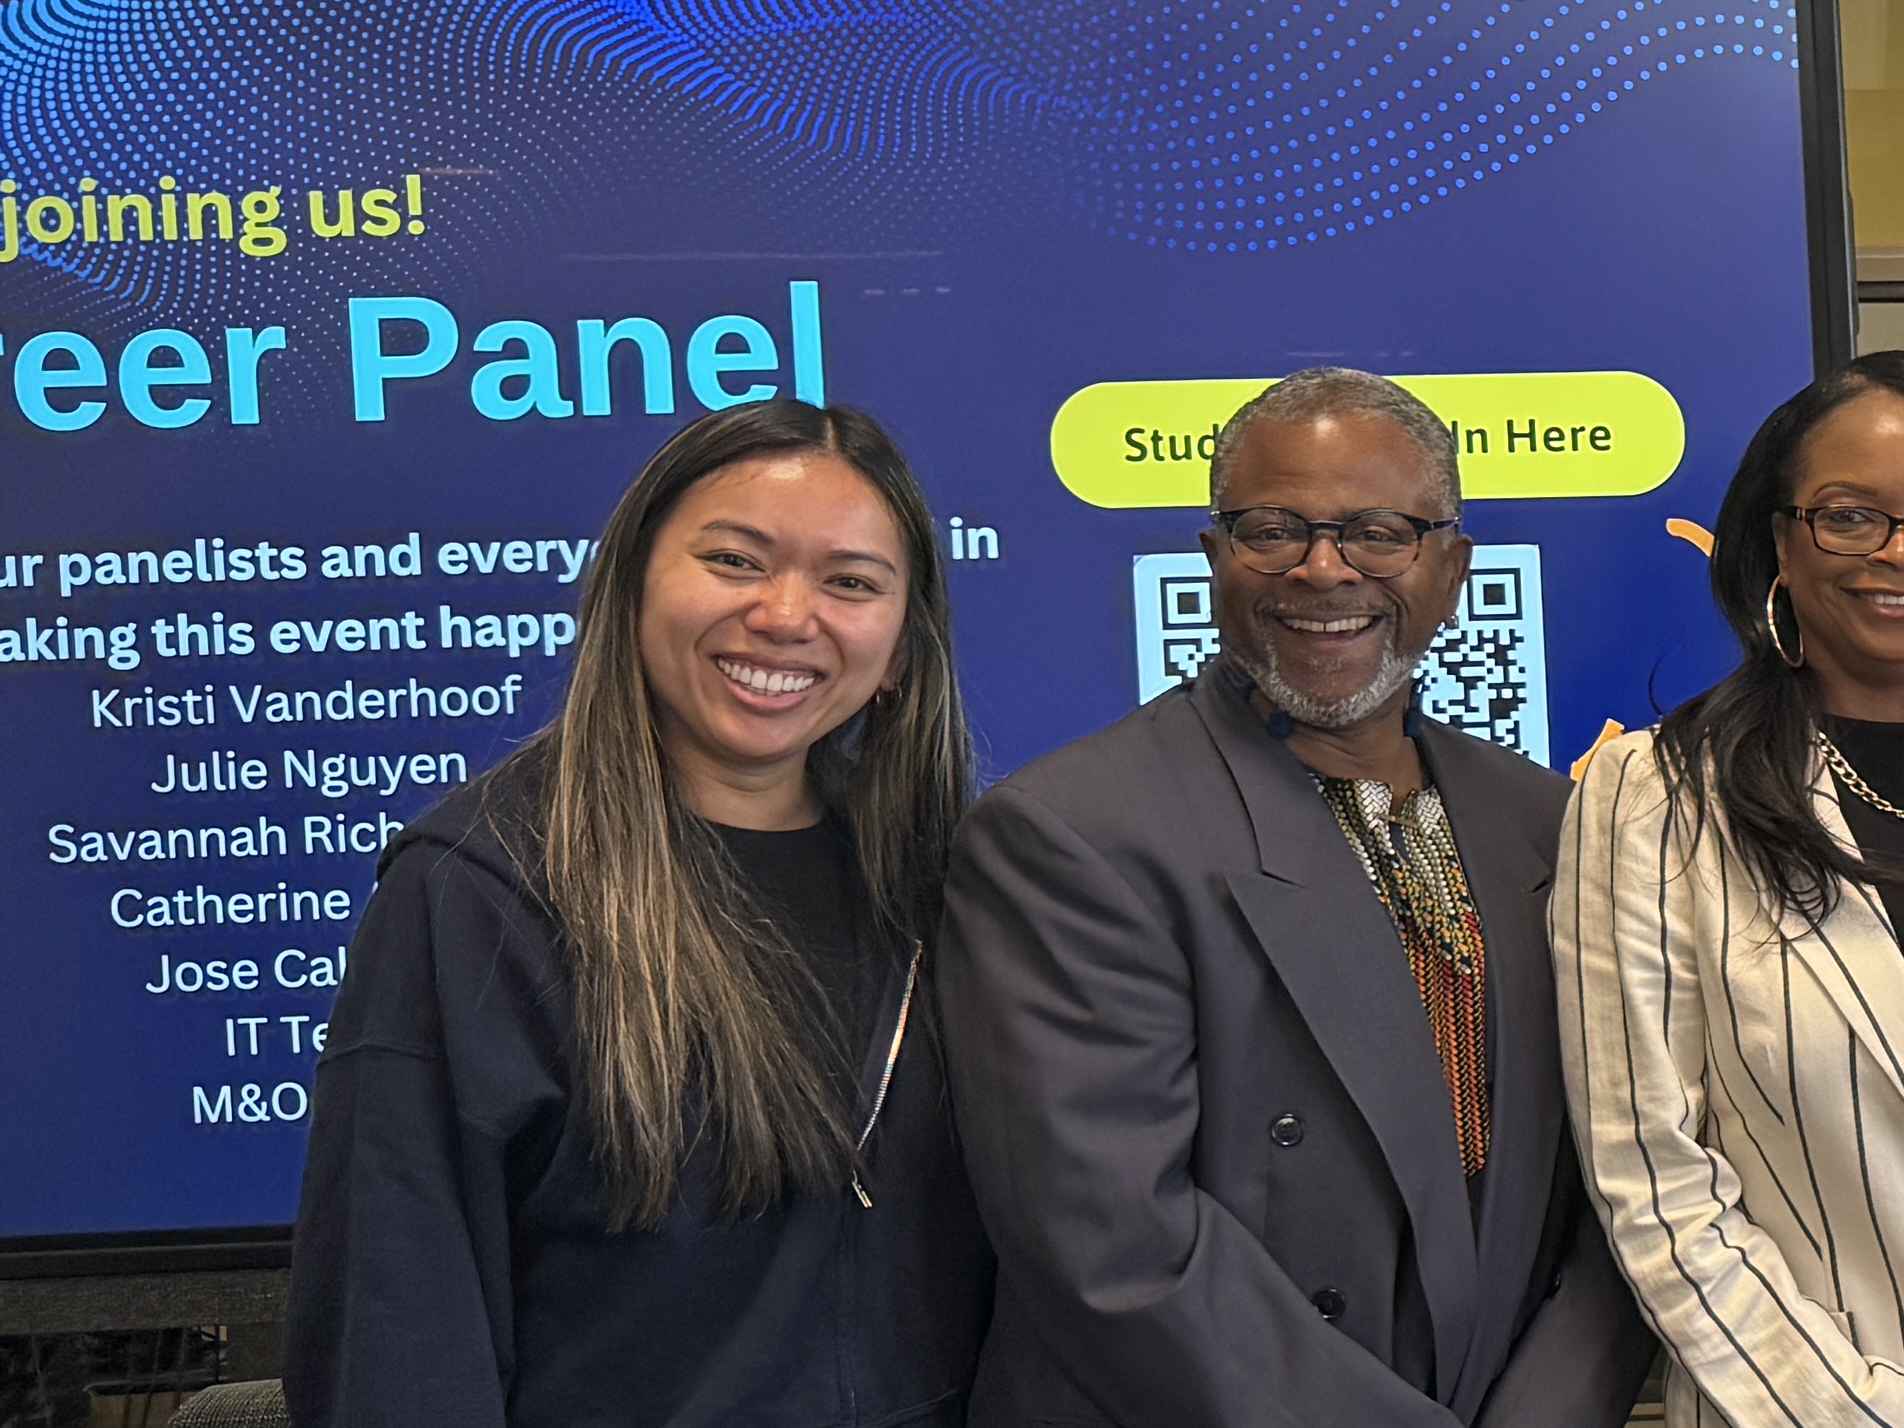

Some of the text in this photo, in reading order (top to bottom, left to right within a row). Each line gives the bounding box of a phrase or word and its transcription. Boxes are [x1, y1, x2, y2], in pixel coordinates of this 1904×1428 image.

[310, 175, 425, 238] us!
[347, 279, 826, 423] Panel
[1506, 418, 1612, 453] Here
[57, 536, 308, 598] panelists
[320, 532, 423, 579] and
[949, 515, 1000, 560] in
[150, 611, 256, 657] this
[268, 610, 428, 655] event
[91, 673, 523, 729] Kristi Vanderhoof
[150, 748, 468, 799] Julie Nguyen
[47, 816, 288, 864] Savannah
[109, 880, 352, 929] Catherine
[144, 954, 260, 994] Jose
[225, 1016, 269, 1058] IT
[192, 1081, 309, 1125] M&O
